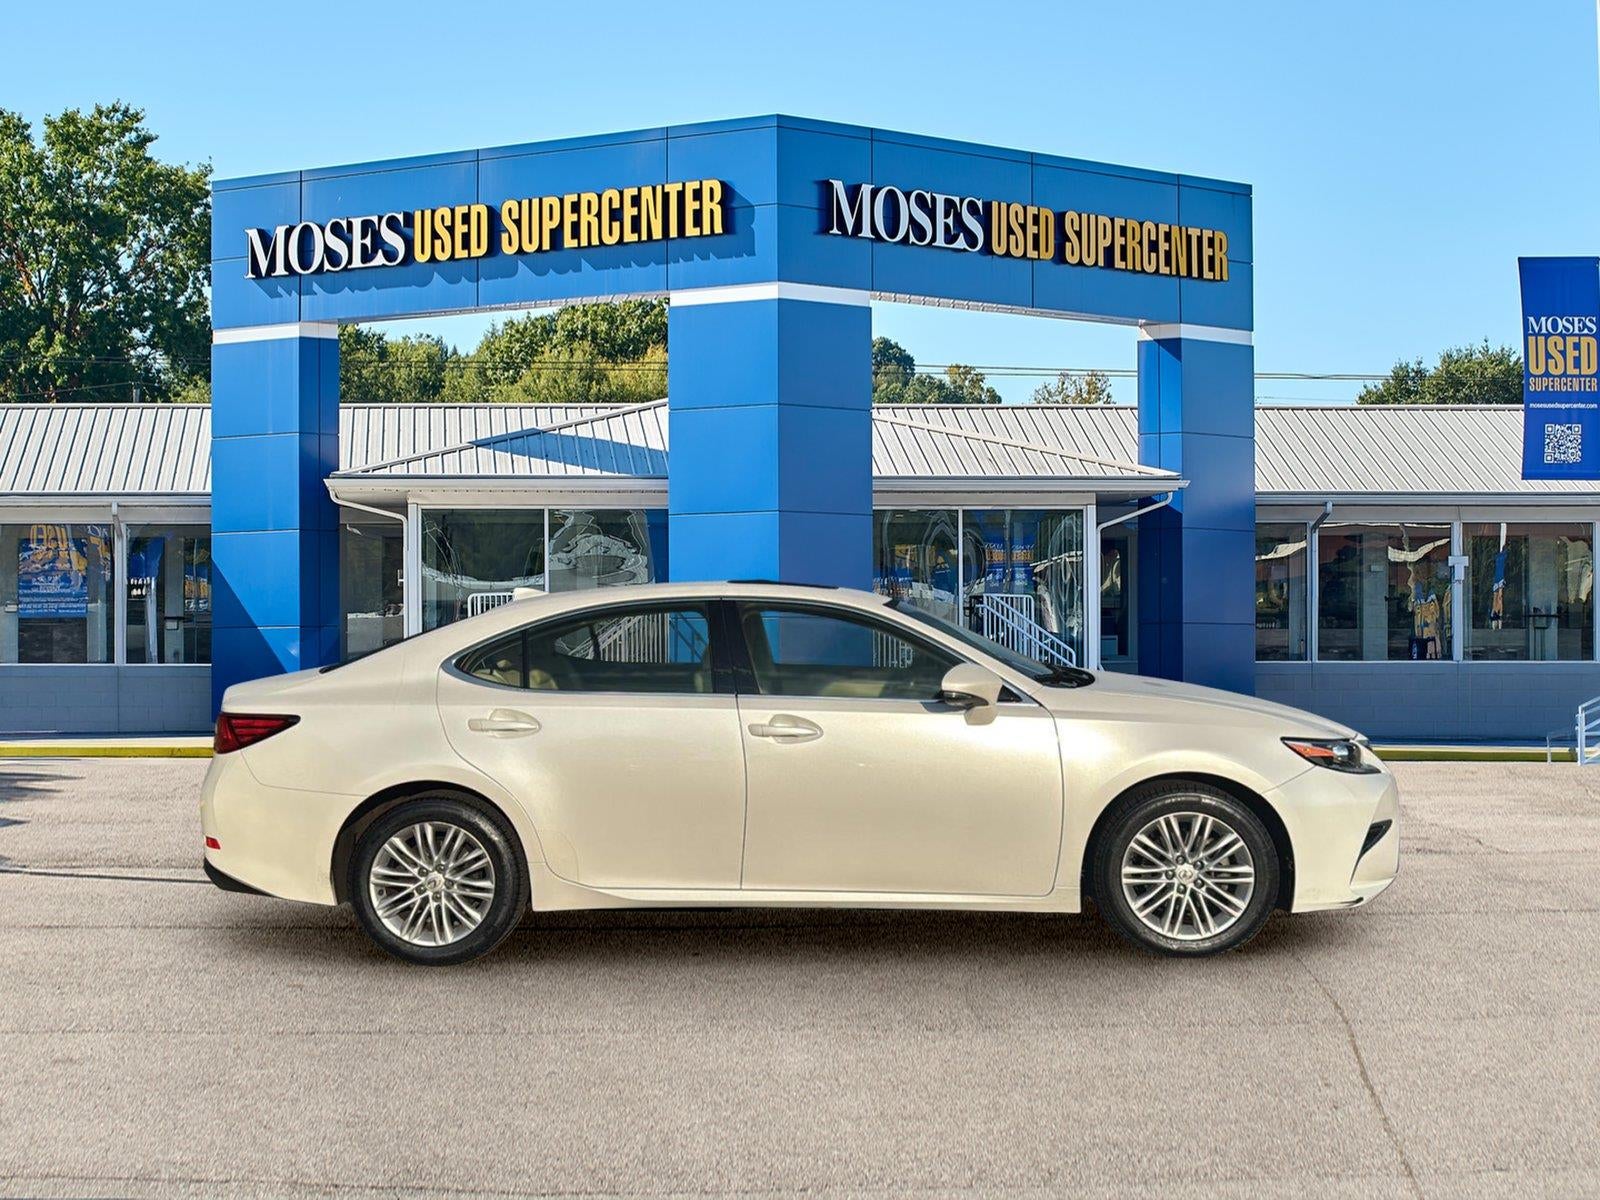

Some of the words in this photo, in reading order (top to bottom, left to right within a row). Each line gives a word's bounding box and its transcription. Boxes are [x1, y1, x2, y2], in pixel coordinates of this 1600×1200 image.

[244, 211, 406, 279] MOSES
[412, 203, 488, 263] USED
[500, 179, 724, 256] SUPERCENTER
[828, 179, 984, 252] MOSES
[991, 200, 1055, 261] USED
[1065, 210, 1229, 282] SUPERCENTER
[1527, 316, 1597, 334] MOSES
[1528, 336, 1598, 376] USED
[1529, 377, 1598, 392] SUPERCENTER
[1529, 402, 1598, 410] mosesusedsupercenter.com
